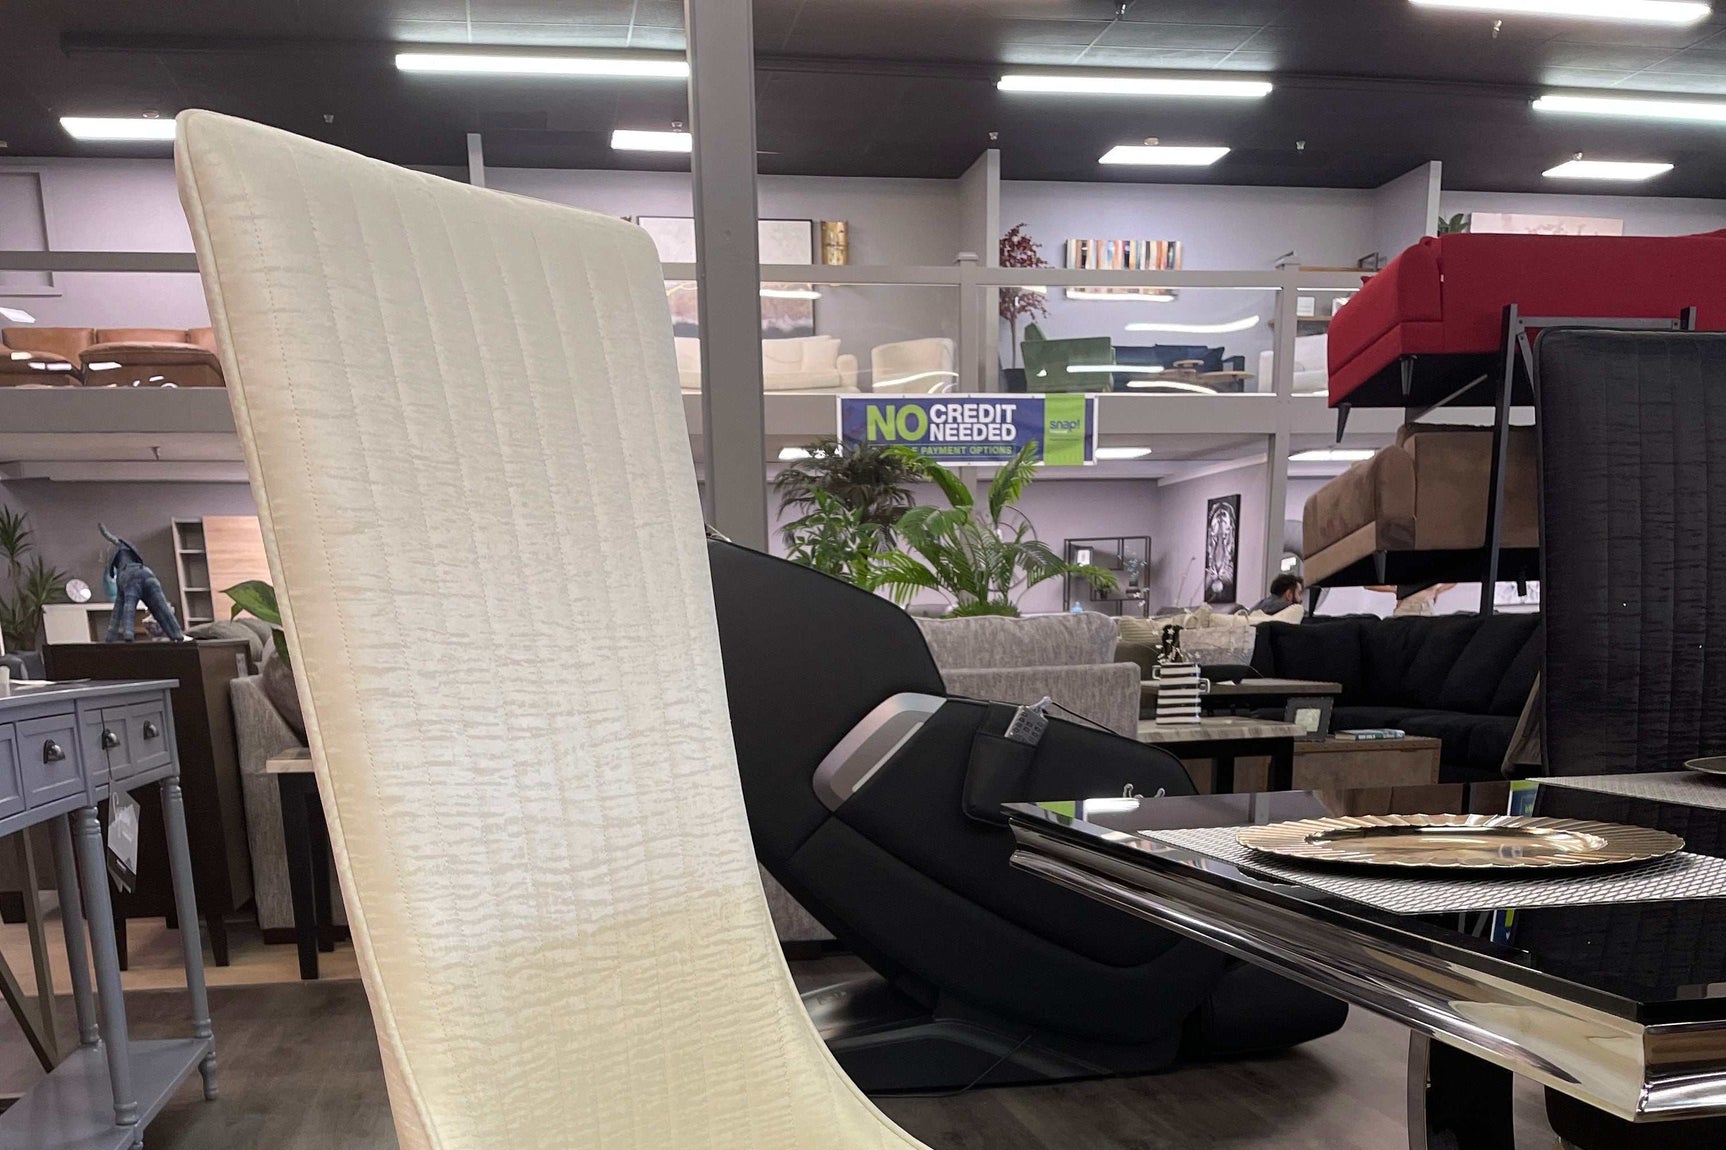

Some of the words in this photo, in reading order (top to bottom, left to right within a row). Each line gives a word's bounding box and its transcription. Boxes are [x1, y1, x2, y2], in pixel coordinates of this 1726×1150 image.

[866, 404, 928, 441] NO
[930, 404, 1016, 423] CREDIT
[1050, 420, 1080, 432] snap!
[930, 424, 1016, 441] NEEDED
[921, 446, 967, 455] PAYMENT
[969, 446, 1013, 455] OPTIONS
